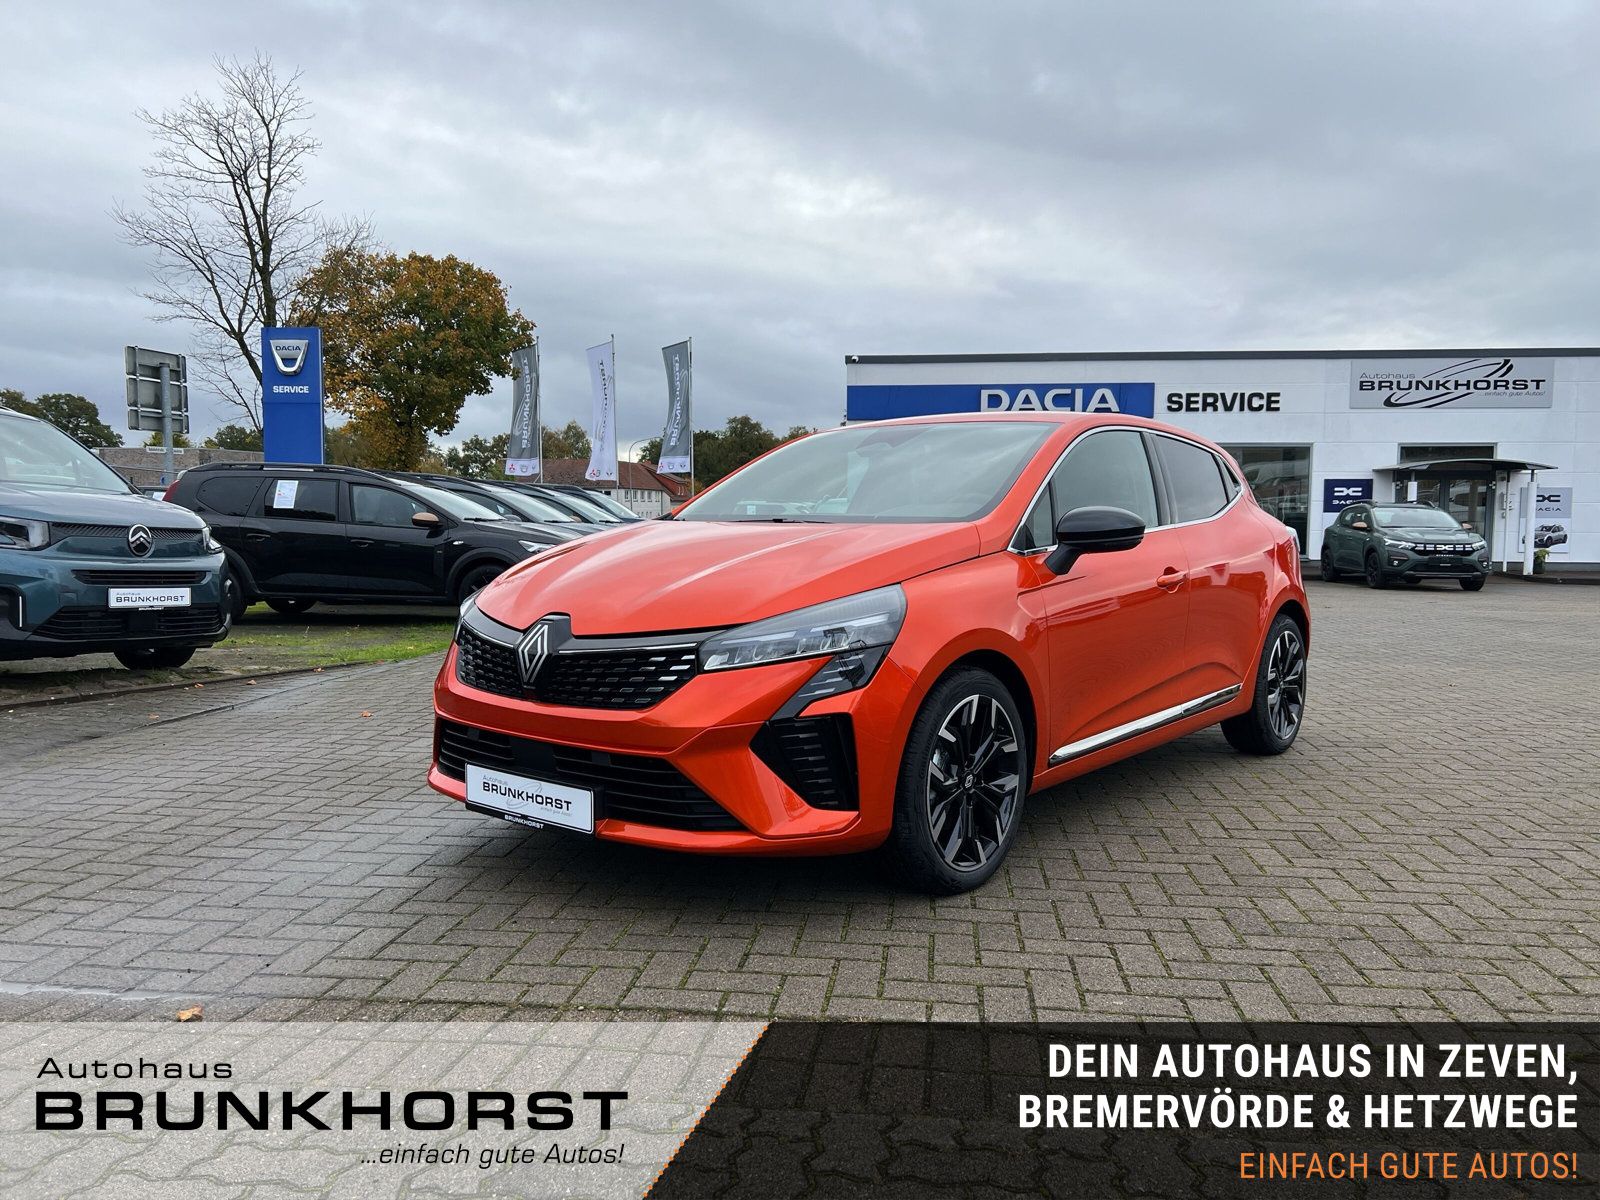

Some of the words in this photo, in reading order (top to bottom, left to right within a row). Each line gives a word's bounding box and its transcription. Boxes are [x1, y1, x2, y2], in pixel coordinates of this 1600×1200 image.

[1360, 372, 1416, 380] Autohaus
[272, 385, 310, 394] SERVICE
[1359, 379, 1546, 391] BRUNKHORST
[980, 388, 1120, 412] DACIA
[1166, 392, 1281, 412] SERVICE
[115, 595, 185, 603] BRUNKHORST
[482, 781, 572, 811] BRUNKHORST
[504, 814, 545, 829] BRUNKHORST
